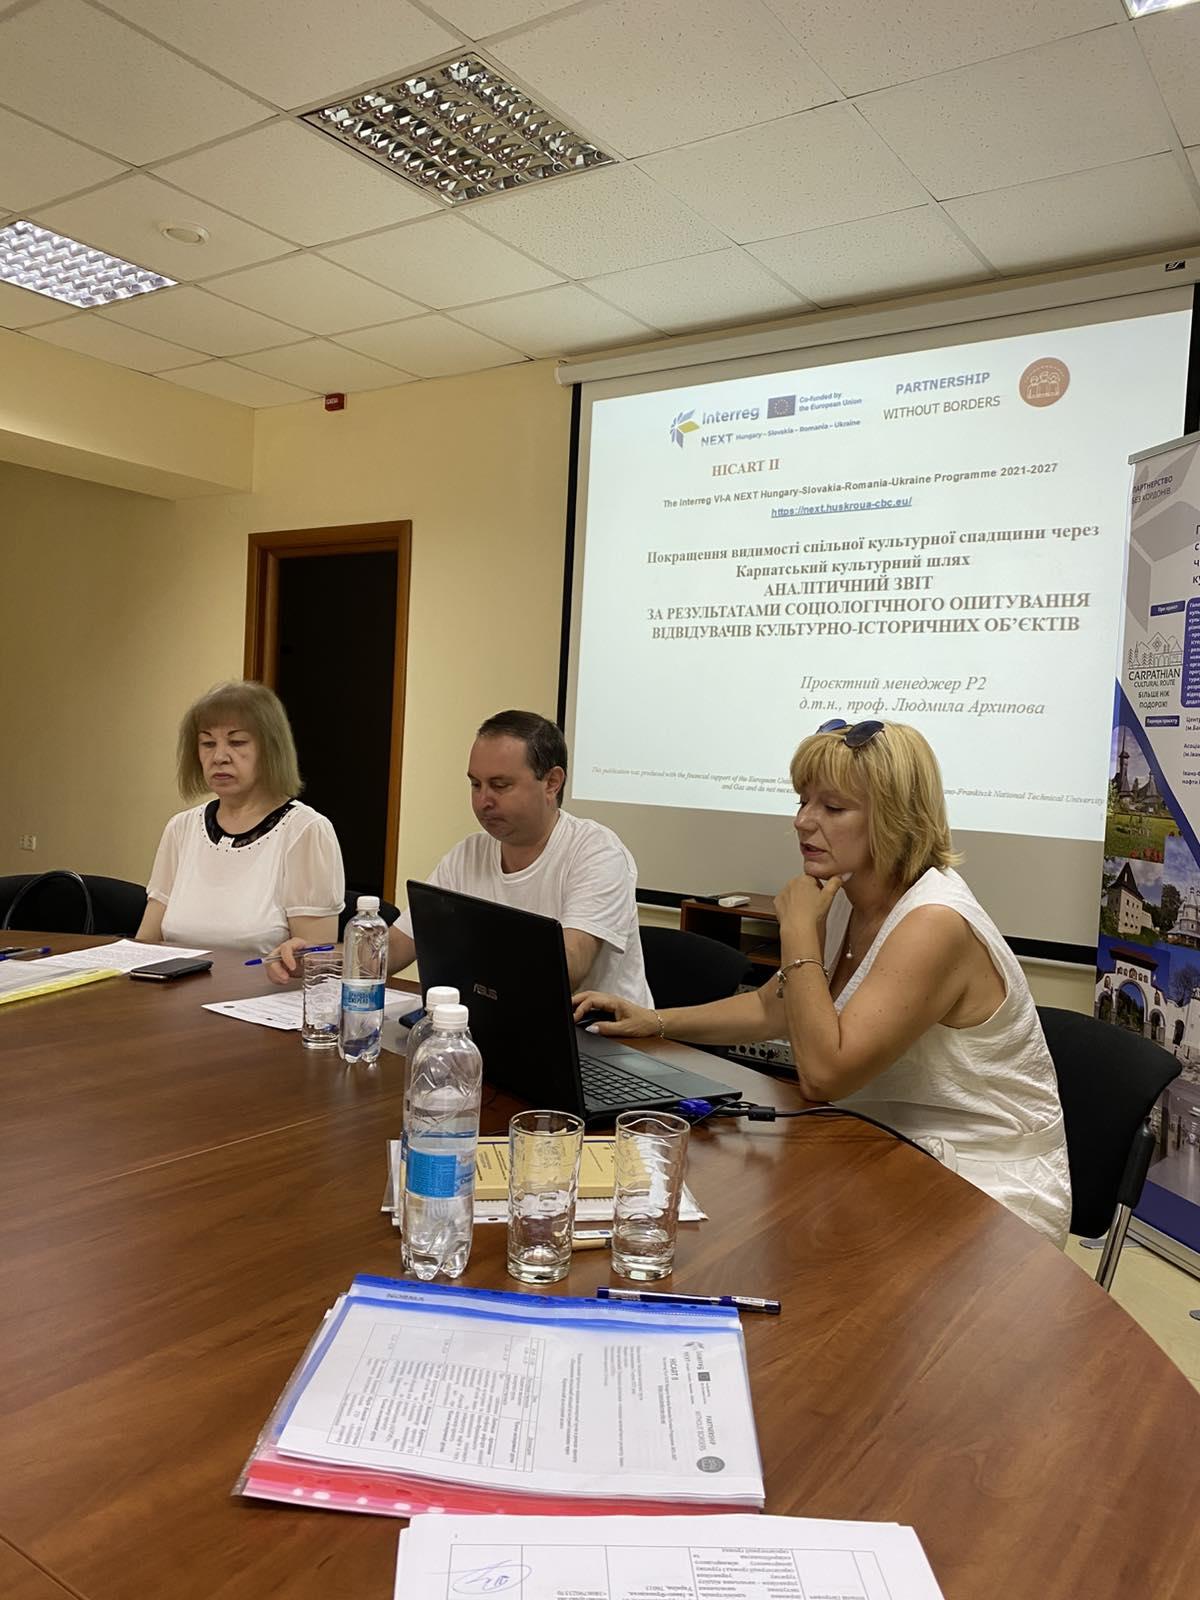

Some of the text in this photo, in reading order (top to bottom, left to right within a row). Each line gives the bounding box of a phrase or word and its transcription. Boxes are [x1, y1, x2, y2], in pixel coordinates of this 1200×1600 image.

[896, 372, 990, 395] PARTNERSHIP
[799, 391, 842, 404] Co-funded by
[799, 398, 862, 412] the European Union
[883, 396, 1001, 420] WITHOUT BORDERS
[702, 407, 760, 425] Interreg
[701, 433, 733, 447] NEXT
[735, 432, 762, 442] Hungary
[799, 423, 829, 433] Romania
[834, 419, 861, 428] Ukraine
[712, 458, 780, 477] HICART II
[663, 462, 1059, 508] The Interreg VI-A NEXT Hungary-Slovakia-Romania-Ukraine Programme 2021-2027
[771, 497, 912, 519] https://next.huskroua-cbc.eu/
[647, 524, 1100, 566] Покращення видимості спільної культурної спадщини через
[736, 555, 971, 580] Карпатський культурний шлях
[763, 574, 933, 597] АНАЛІТИЧНИЙ ЗВІТ
[647, 592, 1091, 620] ЗА РЕЗУЛЬТАТАМИ СОЦІОЛОГІЧНОГО ОПИТУВАННЯ
[652, 624, 752, 640] ВІДВІДУВАЧІВ
[755, 618, 980, 638] КУЛЬТУРНО-ІСТОРИЧНИХ
[800, 675, 880, 691] Проєктний
[883, 676, 962, 694] менеджер
[1128, 668, 1180, 680] CARPATHIAN
[1134, 679, 1175, 688] CULTURAL ROUTE
[799, 697, 1045, 717] д.т.н., проф. Людмила Архипова
[473, 983, 498, 1001] ASUS
